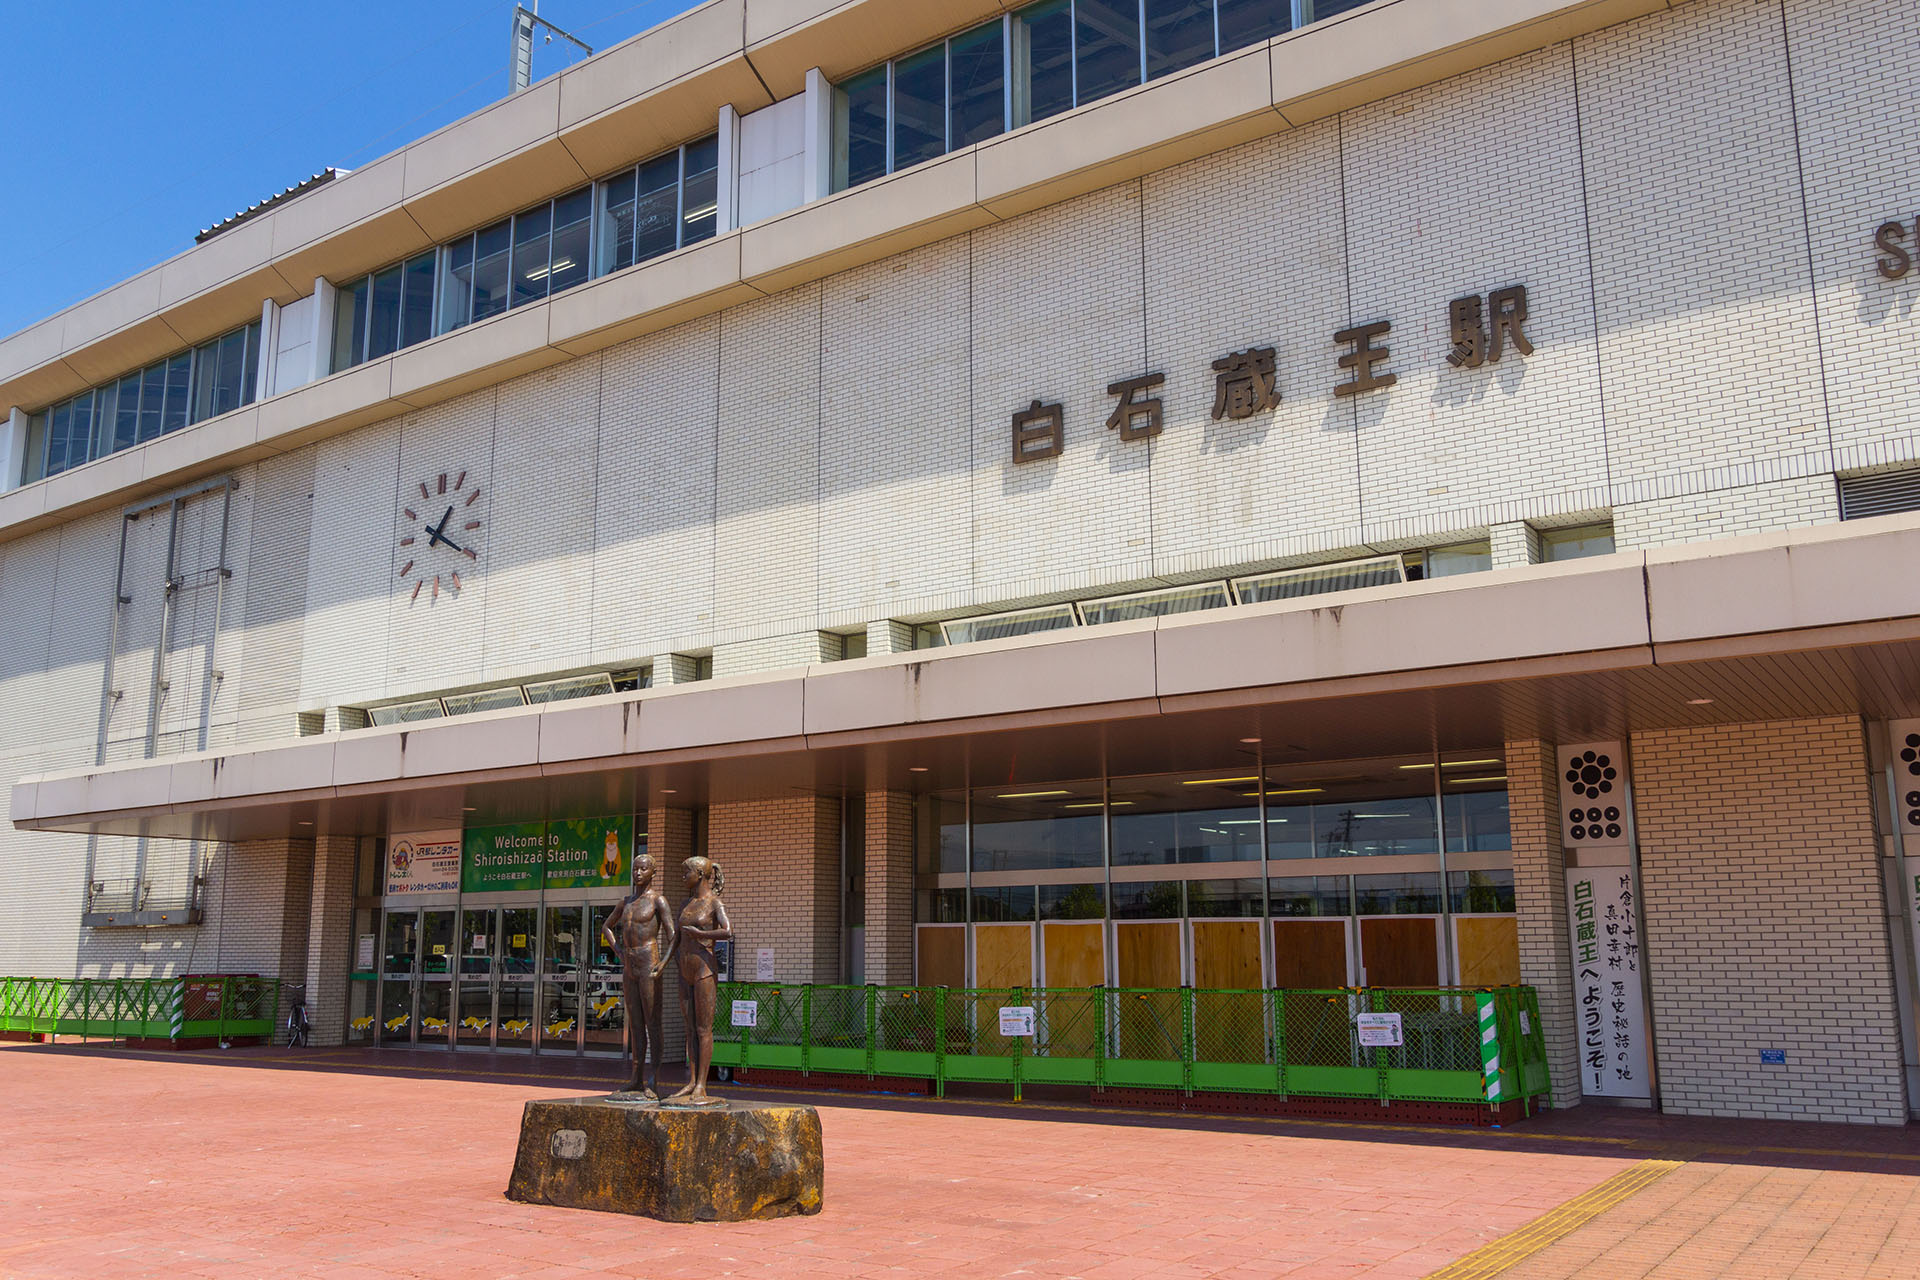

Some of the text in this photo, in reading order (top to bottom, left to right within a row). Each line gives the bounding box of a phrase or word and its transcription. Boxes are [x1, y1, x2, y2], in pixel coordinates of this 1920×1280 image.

[1876, 215, 1920, 278] S
[1012, 285, 1534, 464] 白石蔵王駅
[495, 833, 559, 848] Welcome to
[547, 848, 588, 862] Station
[483, 871, 532, 881] ようこそ白石蔵王駅へ
[1619, 874, 1638, 971] 片倉小十郎と
[1605, 904, 1633, 1080] 真田幸村 歴史秘話の地
